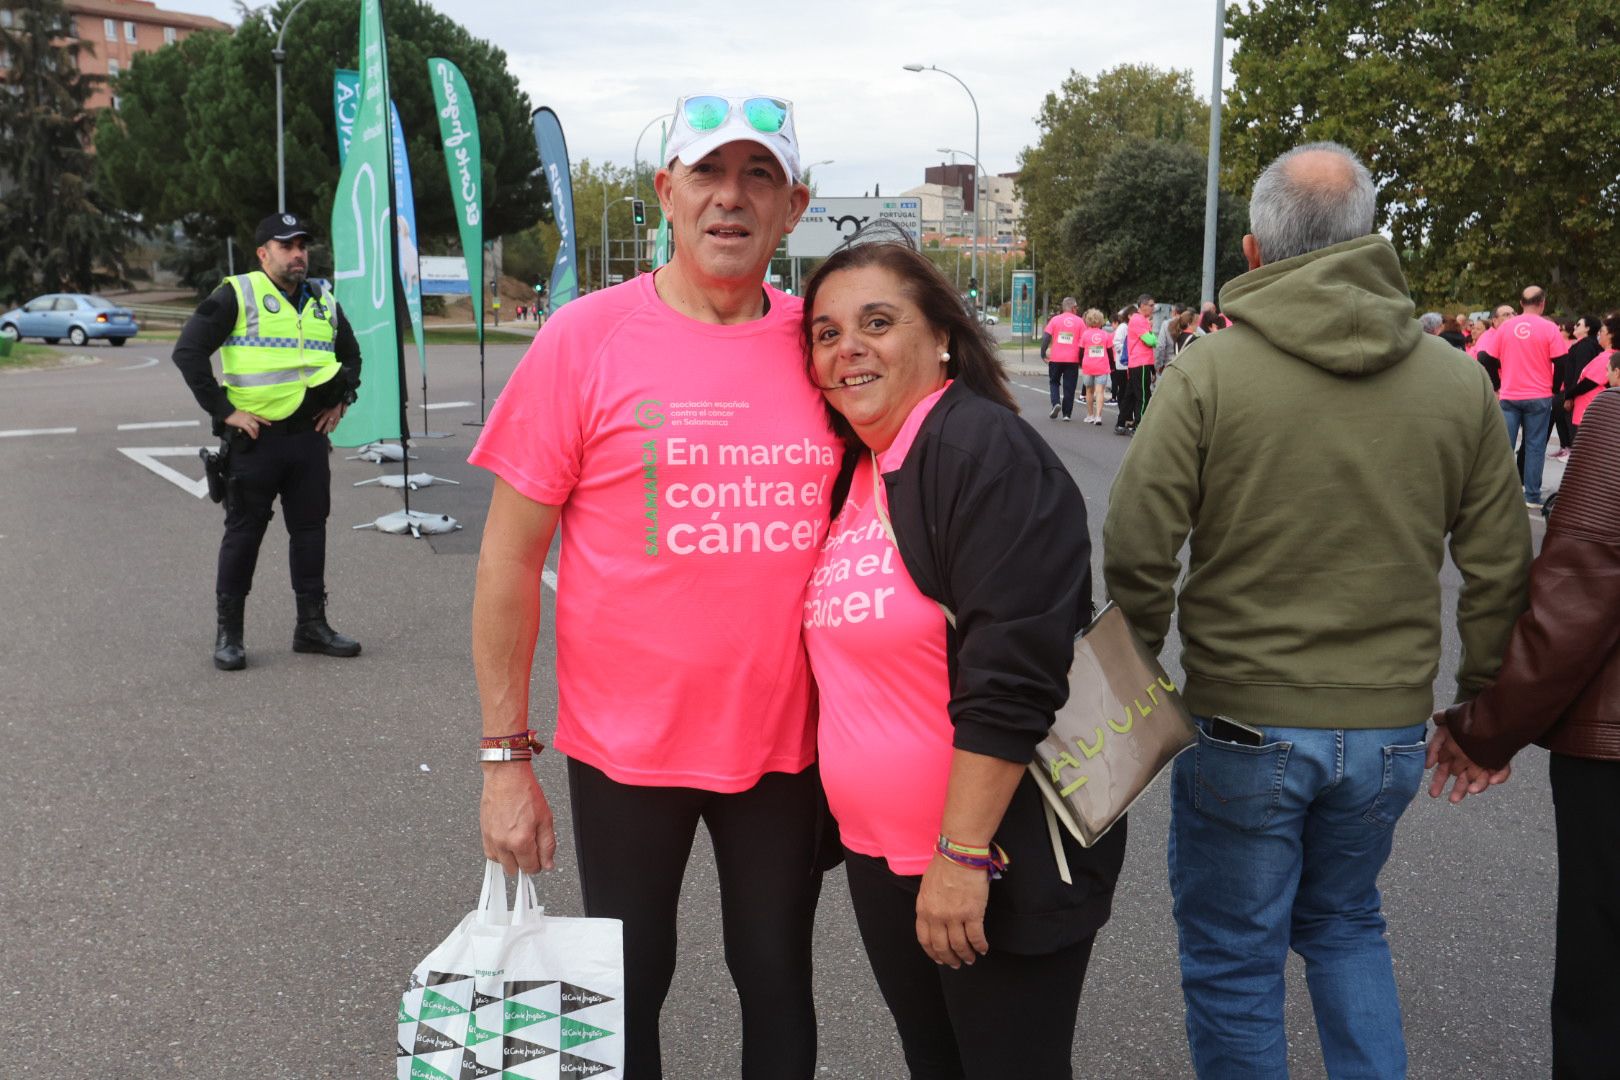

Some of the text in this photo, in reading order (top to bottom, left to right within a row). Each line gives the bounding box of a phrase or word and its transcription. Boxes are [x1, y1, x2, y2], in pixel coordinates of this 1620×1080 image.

[669, 400, 750, 410] asociación española
[670, 409, 698, 417] contra
[699, 409, 707, 417] el
[683, 418, 729, 426] Salamanca
[667, 437, 835, 466] En marcha
[665, 473, 828, 509] contra el
[642, 439, 660, 556] SALAMANCA
[666, 511, 823, 555] cáncer
[855, 547, 894, 577] el
[567, 993, 582, 1001] Corte
[511, 1012, 525, 1020] Corte
[567, 1064, 582, 1072] Corte
